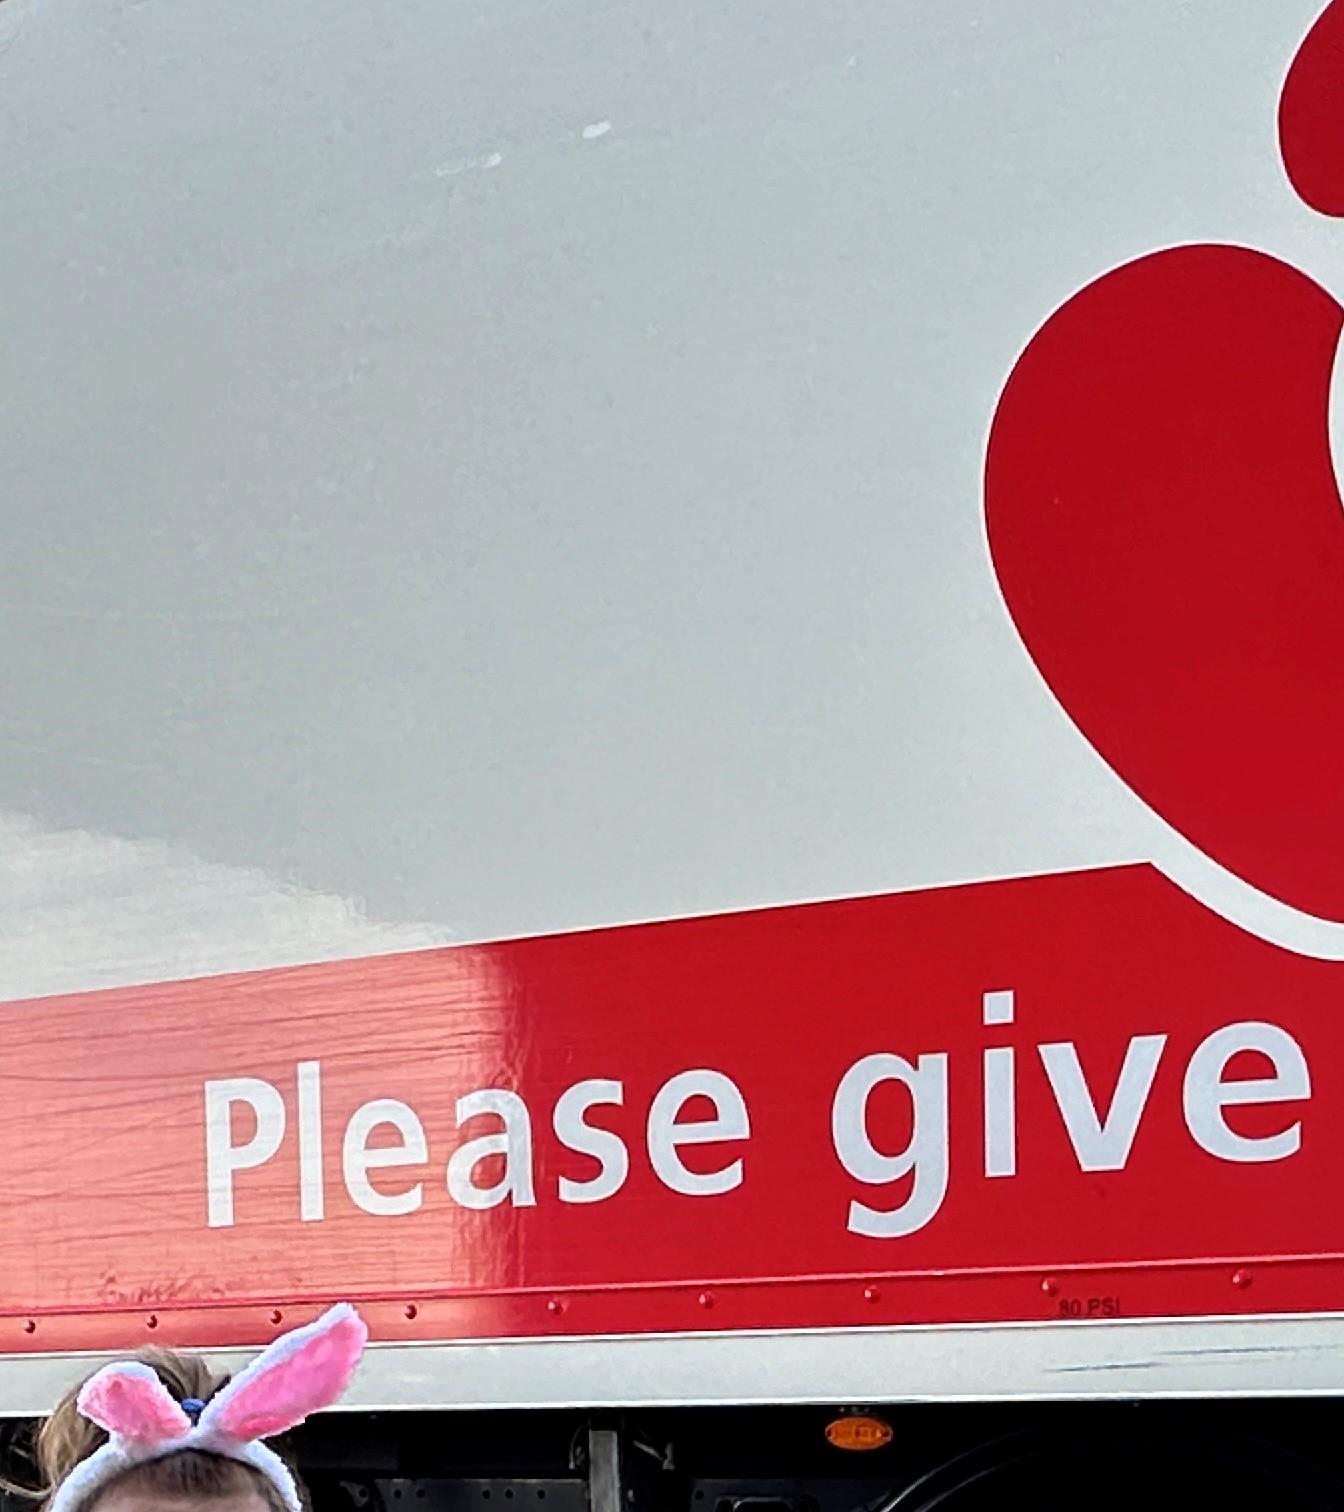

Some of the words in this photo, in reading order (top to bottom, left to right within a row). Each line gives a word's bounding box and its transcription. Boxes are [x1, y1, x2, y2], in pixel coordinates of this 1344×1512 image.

[205, 1060, 750, 1228] Please
[831, 989, 1312, 1238] give
[1087, 1296, 1121, 1316] PSI
